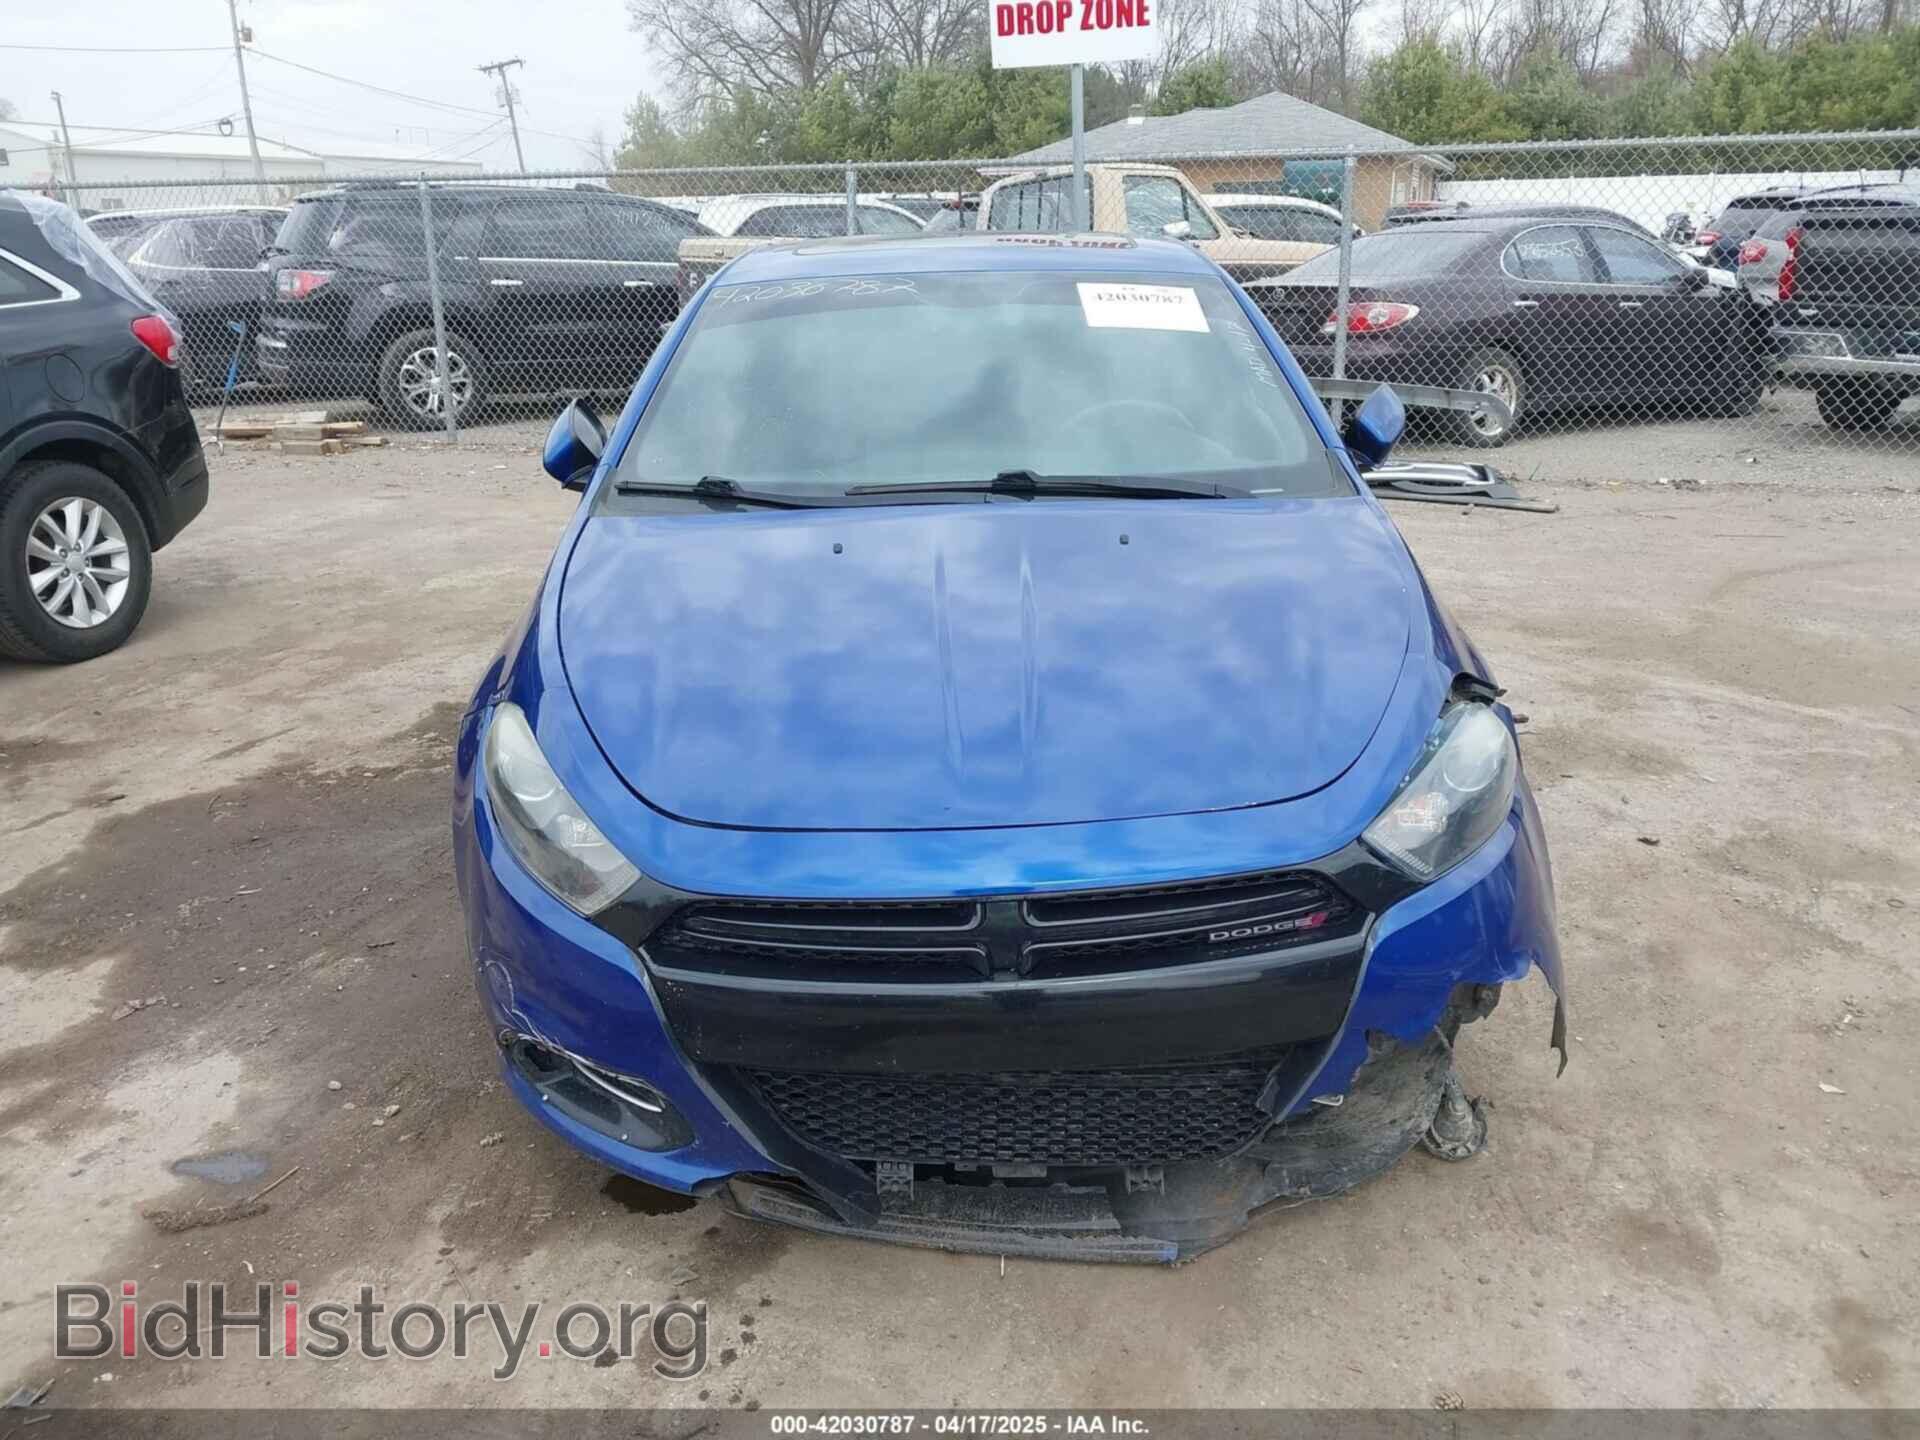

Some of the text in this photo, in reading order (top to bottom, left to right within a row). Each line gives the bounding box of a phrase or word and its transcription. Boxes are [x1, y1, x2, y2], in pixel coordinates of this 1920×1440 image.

[997, 0, 1150, 36] DROP ZONE
[1209, 917, 1313, 942] DODGE
